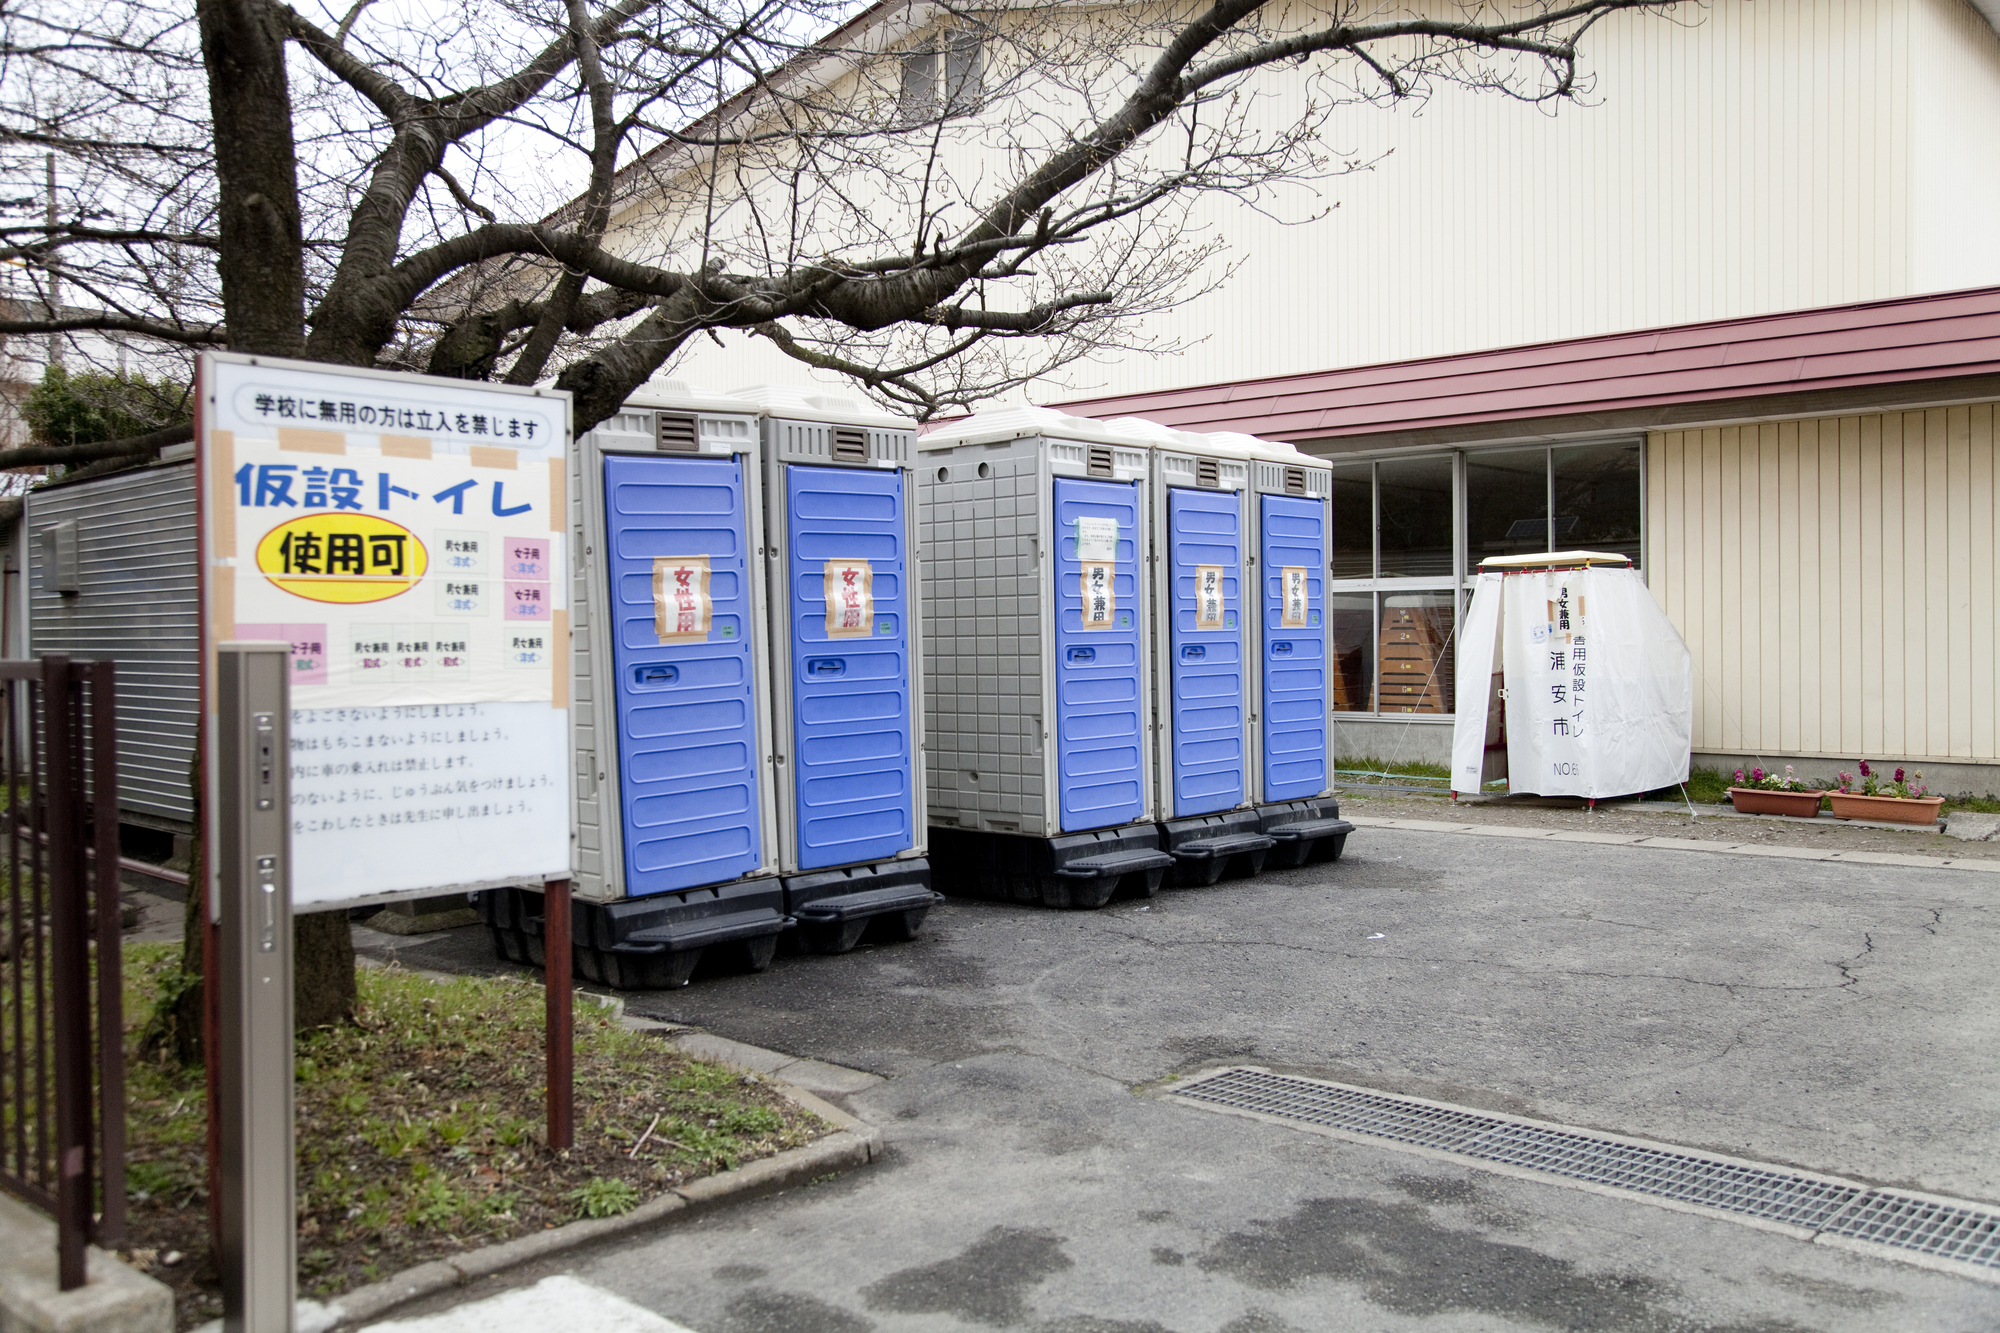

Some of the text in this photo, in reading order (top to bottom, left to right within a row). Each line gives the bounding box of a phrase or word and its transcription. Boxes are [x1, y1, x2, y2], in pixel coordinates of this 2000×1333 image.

[255, 393, 539, 439] 学校に無用の方は立入を禁じます
[234, 462, 533, 517] 仮設トイレ
[279, 530, 407, 576] 使用可
[445, 540, 478, 553] 男女兼用
[513, 547, 540, 560] 女子用
[446, 583, 479, 596] 男女兼用
[514, 589, 541, 601] 女子用
[674, 566, 697, 632] 女性用
[841, 567, 861, 628] 女性用
[1400, 632, 1406, 640] 2
[354, 642, 390, 654] 男女兼用
[396, 641, 429, 653] 男女兼用
[435, 641, 467, 653] 男女兼用
[512, 637, 543, 649] 男女兼用
[1400, 662, 1406, 670] 4
